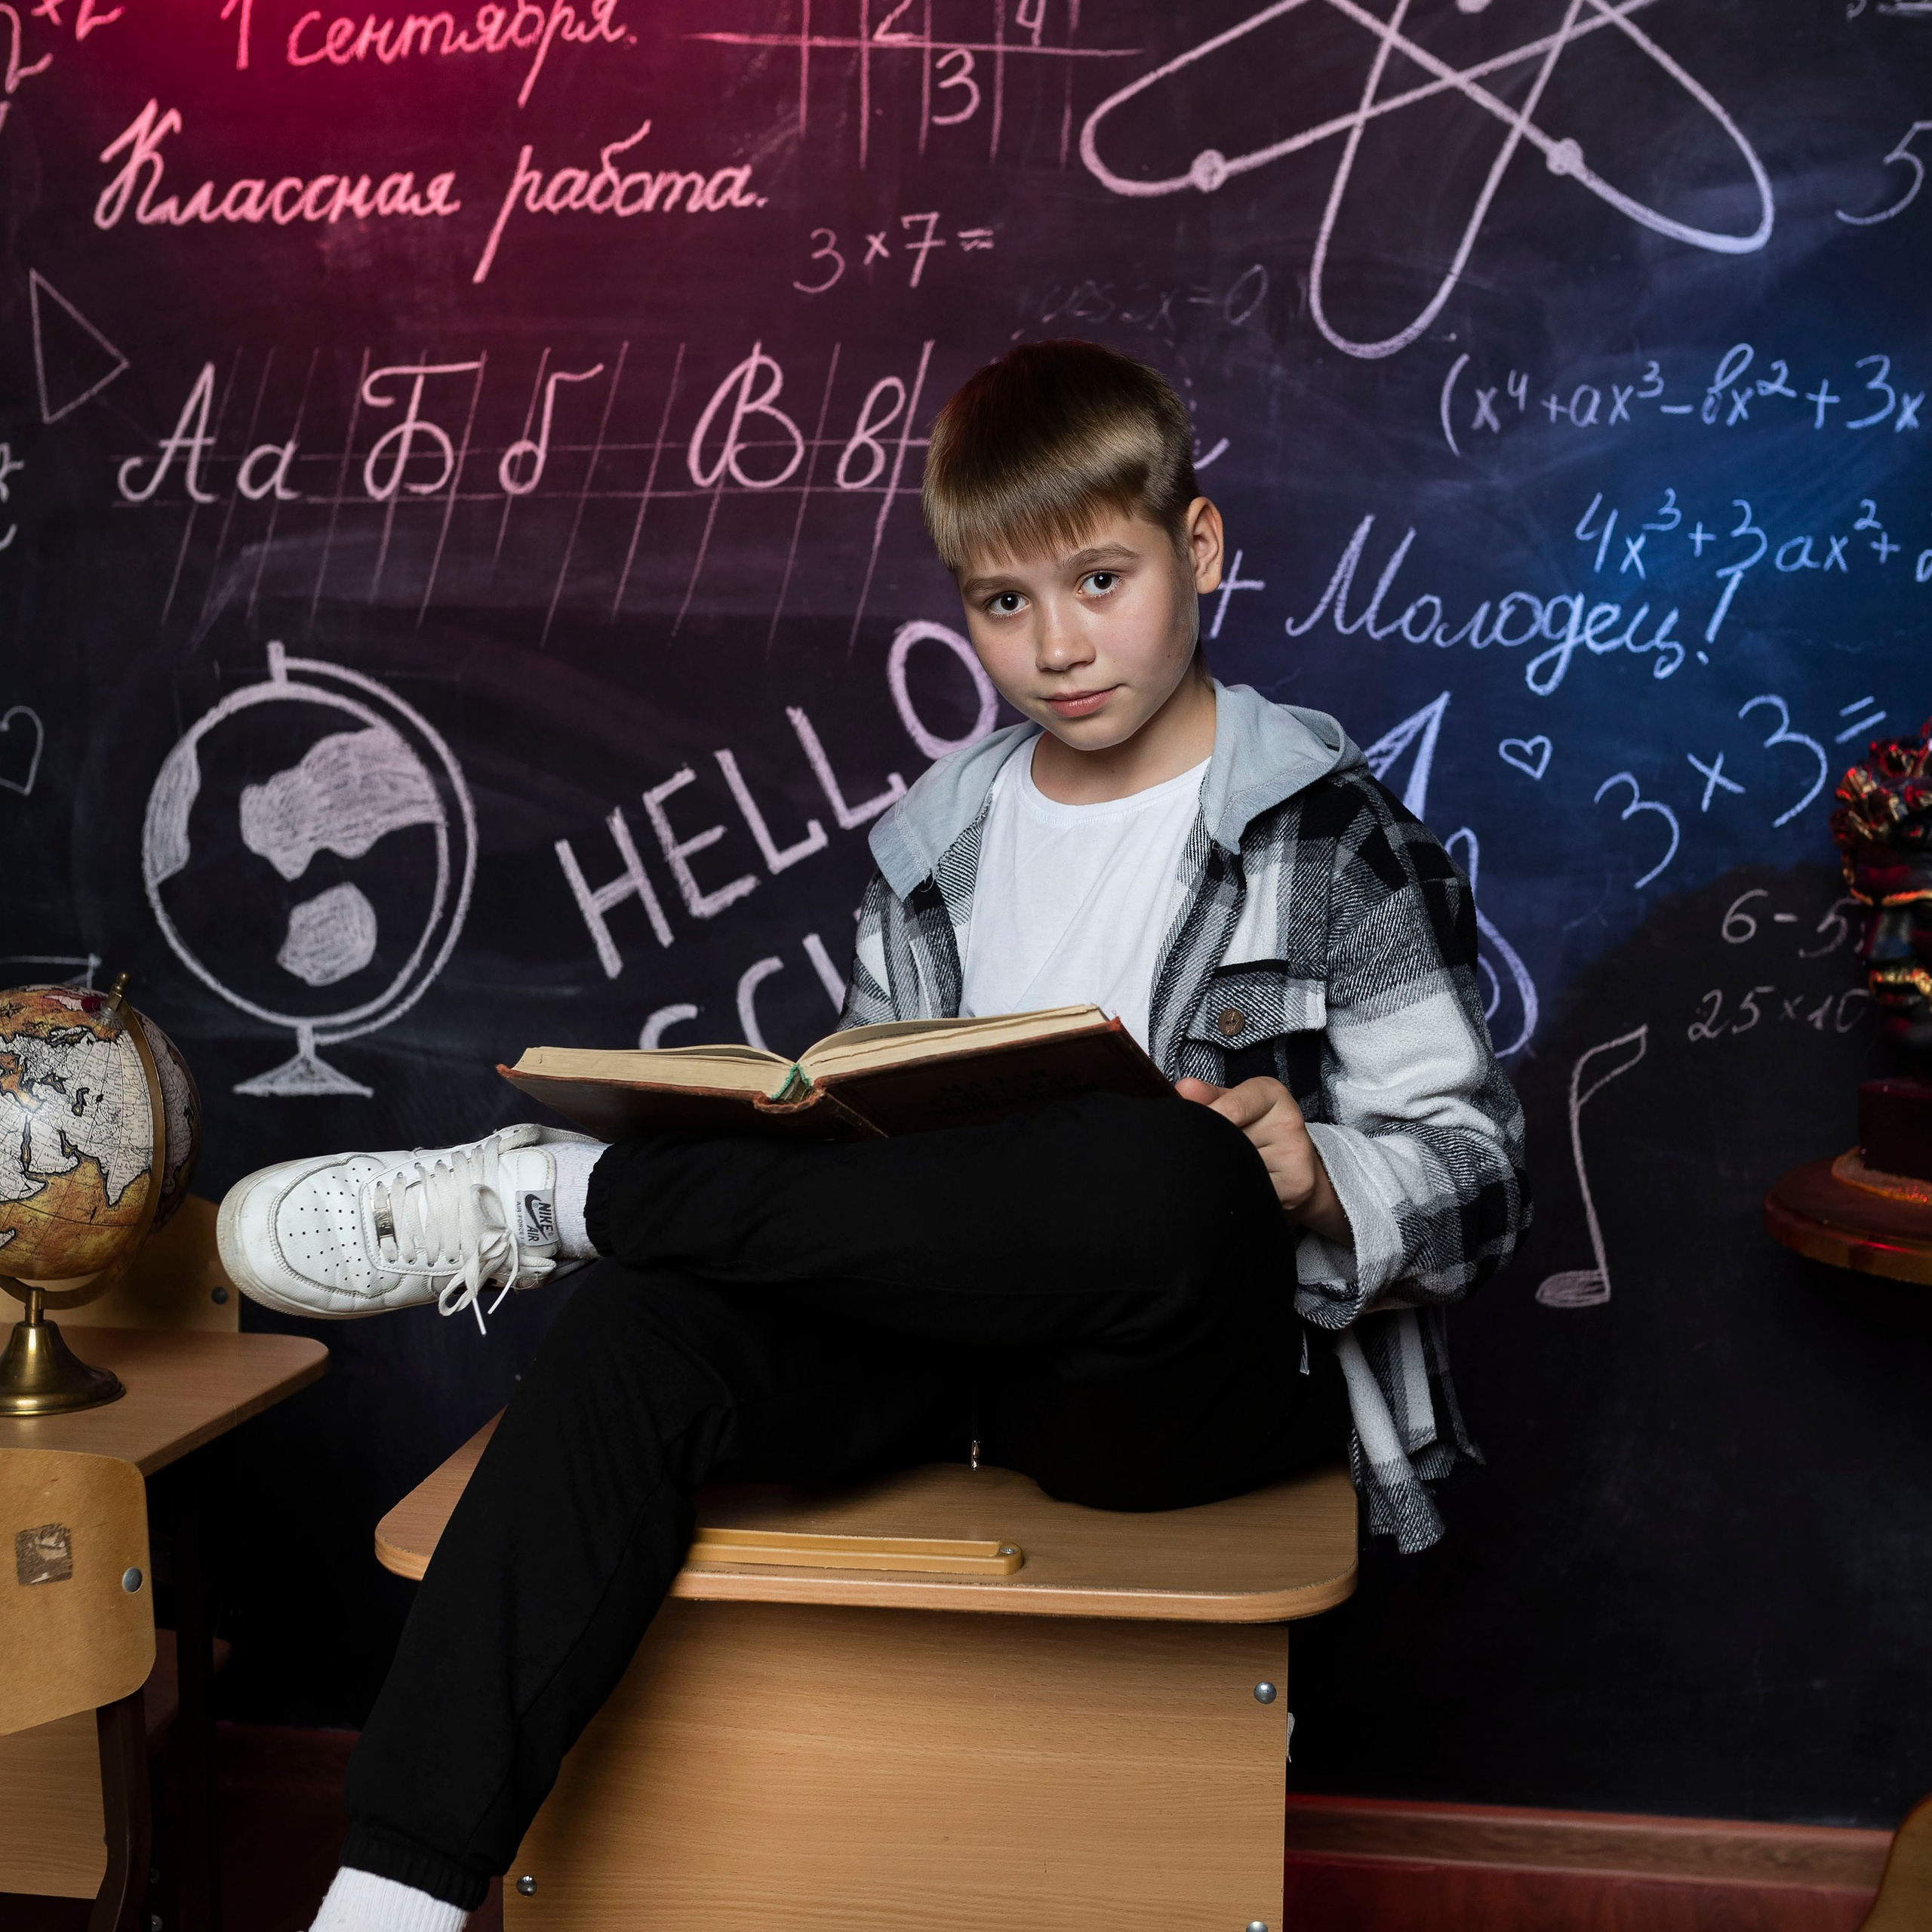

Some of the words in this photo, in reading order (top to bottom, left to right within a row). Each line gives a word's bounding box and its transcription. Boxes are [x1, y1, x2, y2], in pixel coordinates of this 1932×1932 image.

[220, 0, 254, 69] 1
[931, 47, 983, 126] 3
[94, 98, 461, 230] Классная
[472, 118, 769, 284] работа.
[1284, 515, 1745, 697] Молодец!
[554, 619, 998, 980] HELLO
[527, 1225, 540, 1242] AIR
[539, 1201, 554, 1232] NIKE
